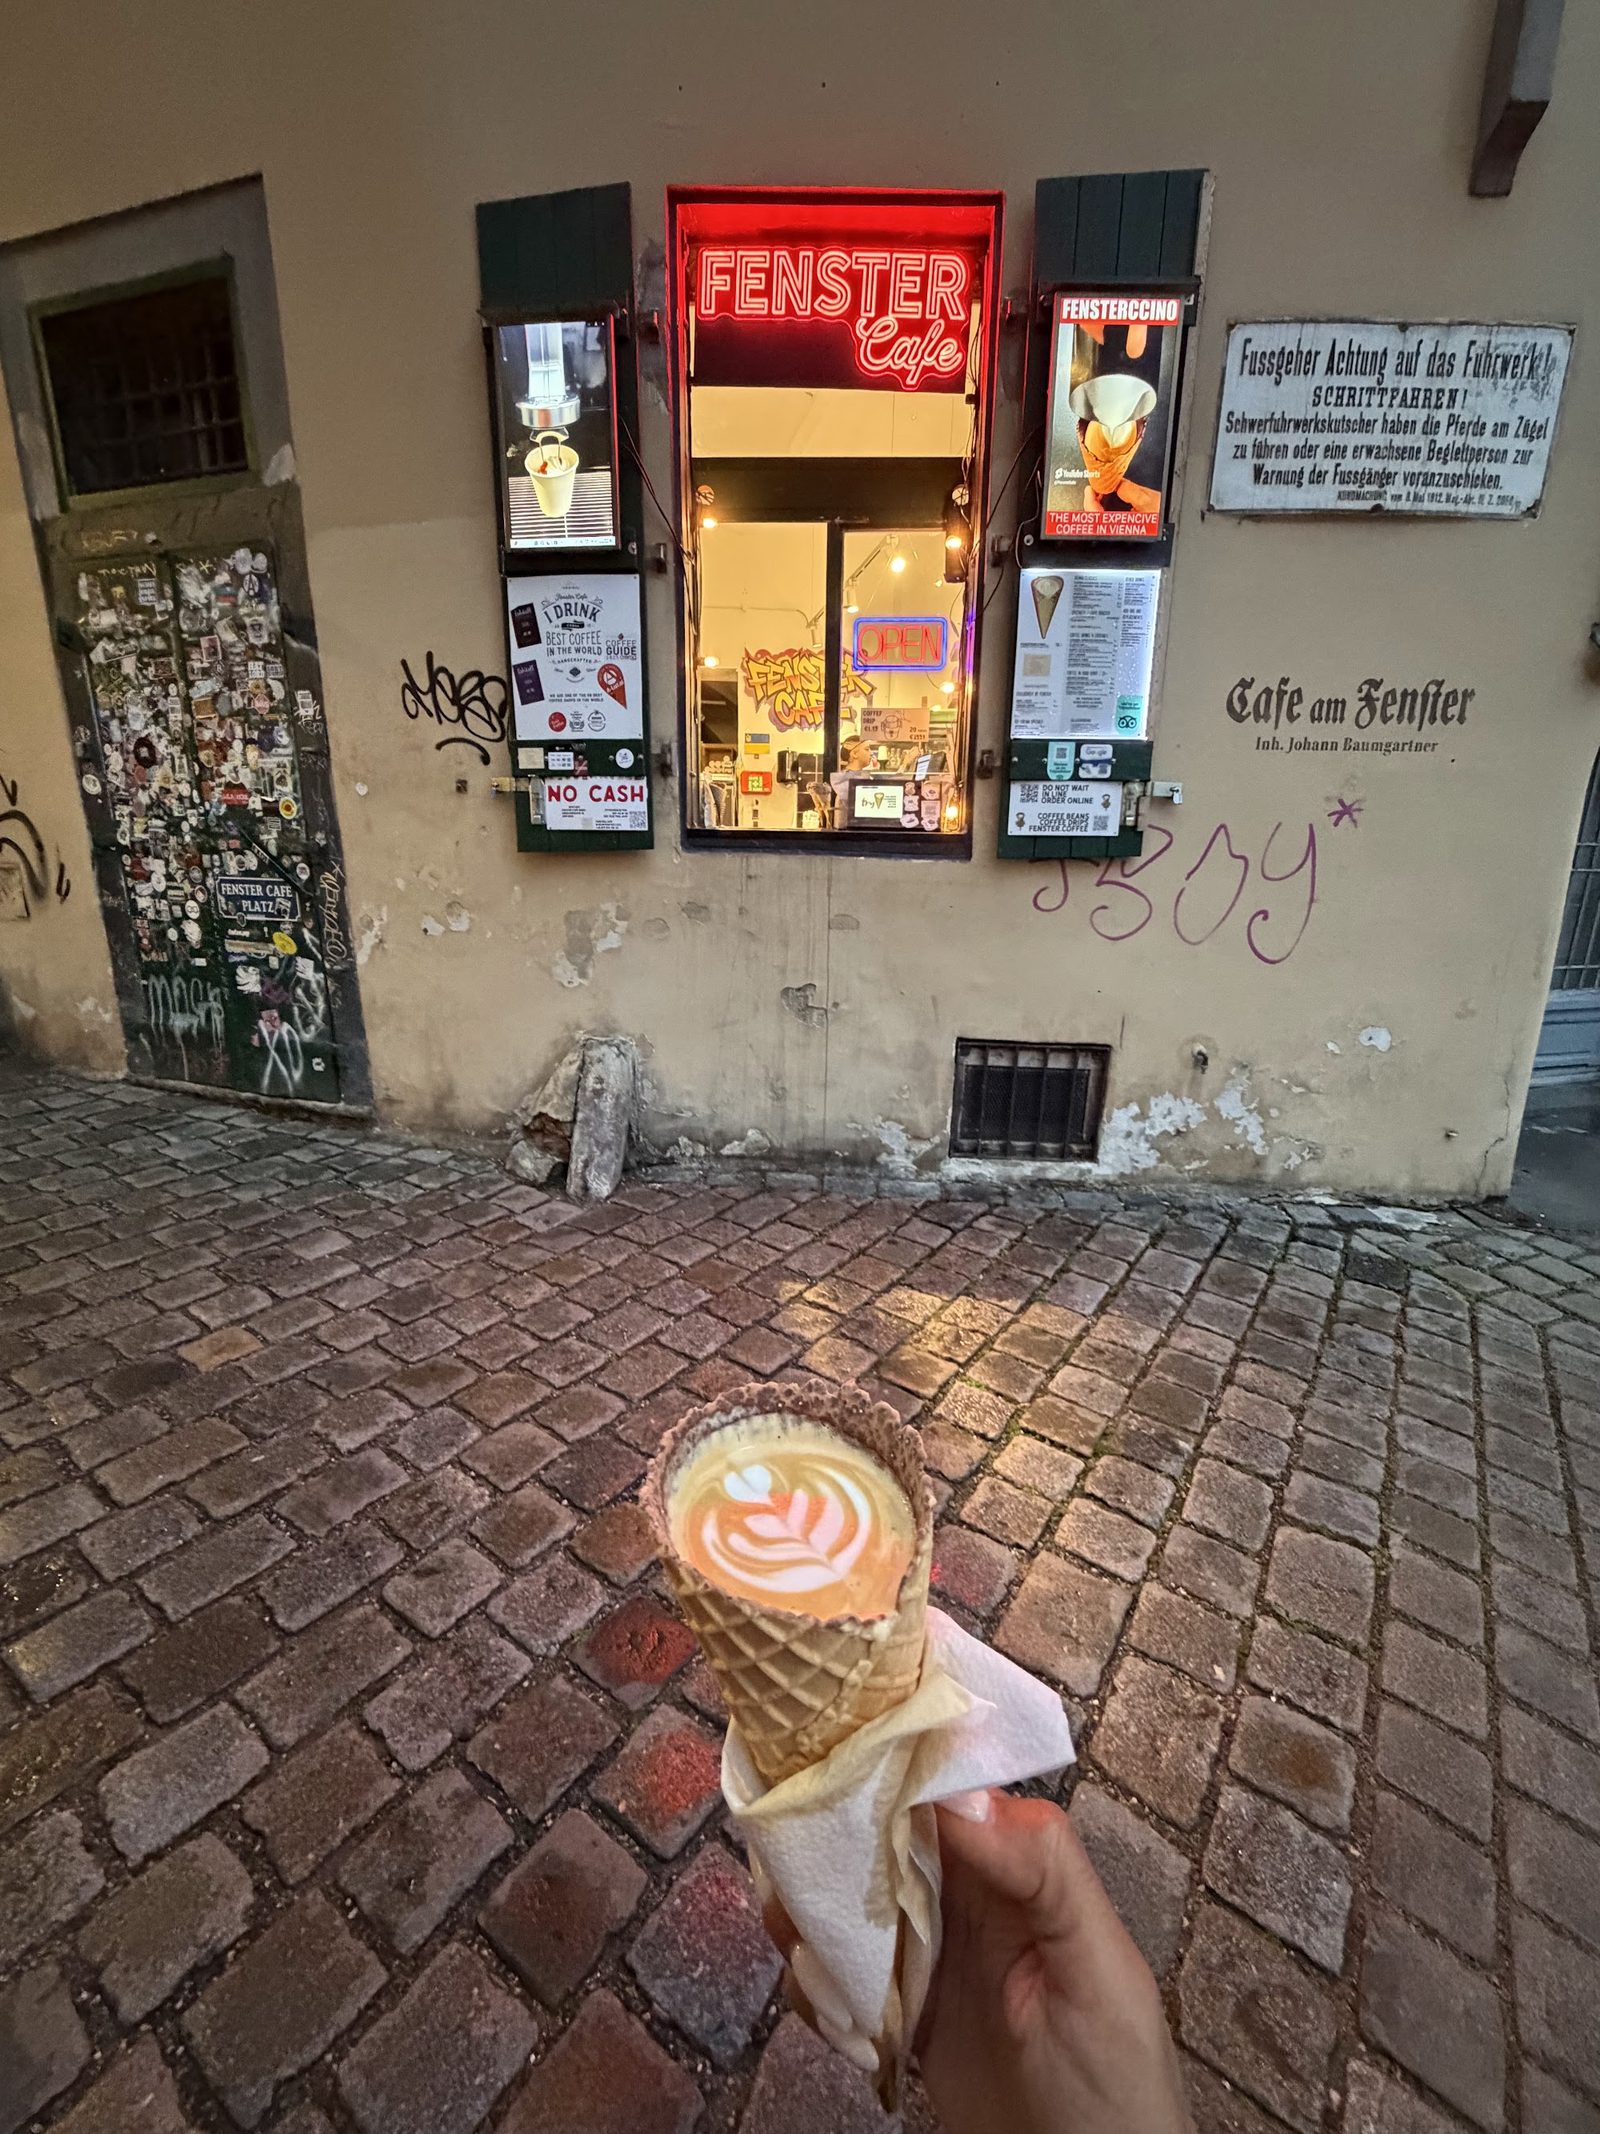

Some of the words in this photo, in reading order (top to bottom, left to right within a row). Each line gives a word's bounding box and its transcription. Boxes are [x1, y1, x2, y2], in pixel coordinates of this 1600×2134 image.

[700, 250, 967, 321] FENSTER
[1061, 299, 1178, 321] FENSTERCCINO
[855, 315, 964, 385] Cafe
[1239, 337, 1321, 386] Fussgeher
[1324, 338, 1388, 386] Achtung
[1394, 339, 1424, 378] auf
[1426, 340, 1456, 379] das
[1381, 412, 1417, 436] haben
[1421, 413, 1441, 437] die
[1446, 413, 1487, 439] Pferde
[1491, 421, 1510, 438] am
[1514, 415, 1550, 442] Zügel
[1232, 444, 1247, 460] zu
[1252, 437, 1289, 460] führen
[1292, 437, 1320, 460] oder
[1323, 440, 1348, 461] eine
[1352, 438, 1422, 463] erwachsene
[1426, 439, 1509, 466] Begleitperson
[1512, 449, 1534, 466] zur
[1253, 463, 1304, 488] Warnung
[1308, 463, 1329, 486] der
[1332, 463, 1398, 489] Fussgänger
[1049, 512, 1069, 523] THE
[1071, 512, 1100, 524] MOST
[1102, 513, 1157, 524] EXPENCIVE
[1056, 523, 1094, 534] COFFEE
[1096, 524, 1107, 534] IN
[1109, 524, 1147, 535] VIENNA
[543, 610, 553, 624] I
[553, 602, 600, 622] DRINK
[546, 631, 566, 646] BEST
[568, 630, 602, 646] COFFEE
[605, 639, 637, 648] COFFEE
[857, 625, 943, 662] OPEN
[546, 647, 555, 657] IN
[557, 646, 572, 655] THE
[574, 646, 602, 656] WORLD
[605, 646, 637, 656] GUIDE
[1226, 676, 1304, 731] Cafe
[1309, 697, 1347, 725] am
[1354, 677, 1476, 732] Fenster
[1255, 736, 1284, 751] Inh.
[1287, 737, 1339, 754] Johann
[1342, 737, 1439, 757] Baumgartner
[547, 785, 577, 803] NO
[588, 784, 644, 803] CASH
[1054, 784, 1069, 792] NOT
[1071, 784, 1090, 792] WAIT
[221, 883, 264, 897] FENSTER
[266, 884, 293, 898] CAFE
[241, 900, 275, 914] PLATZ
